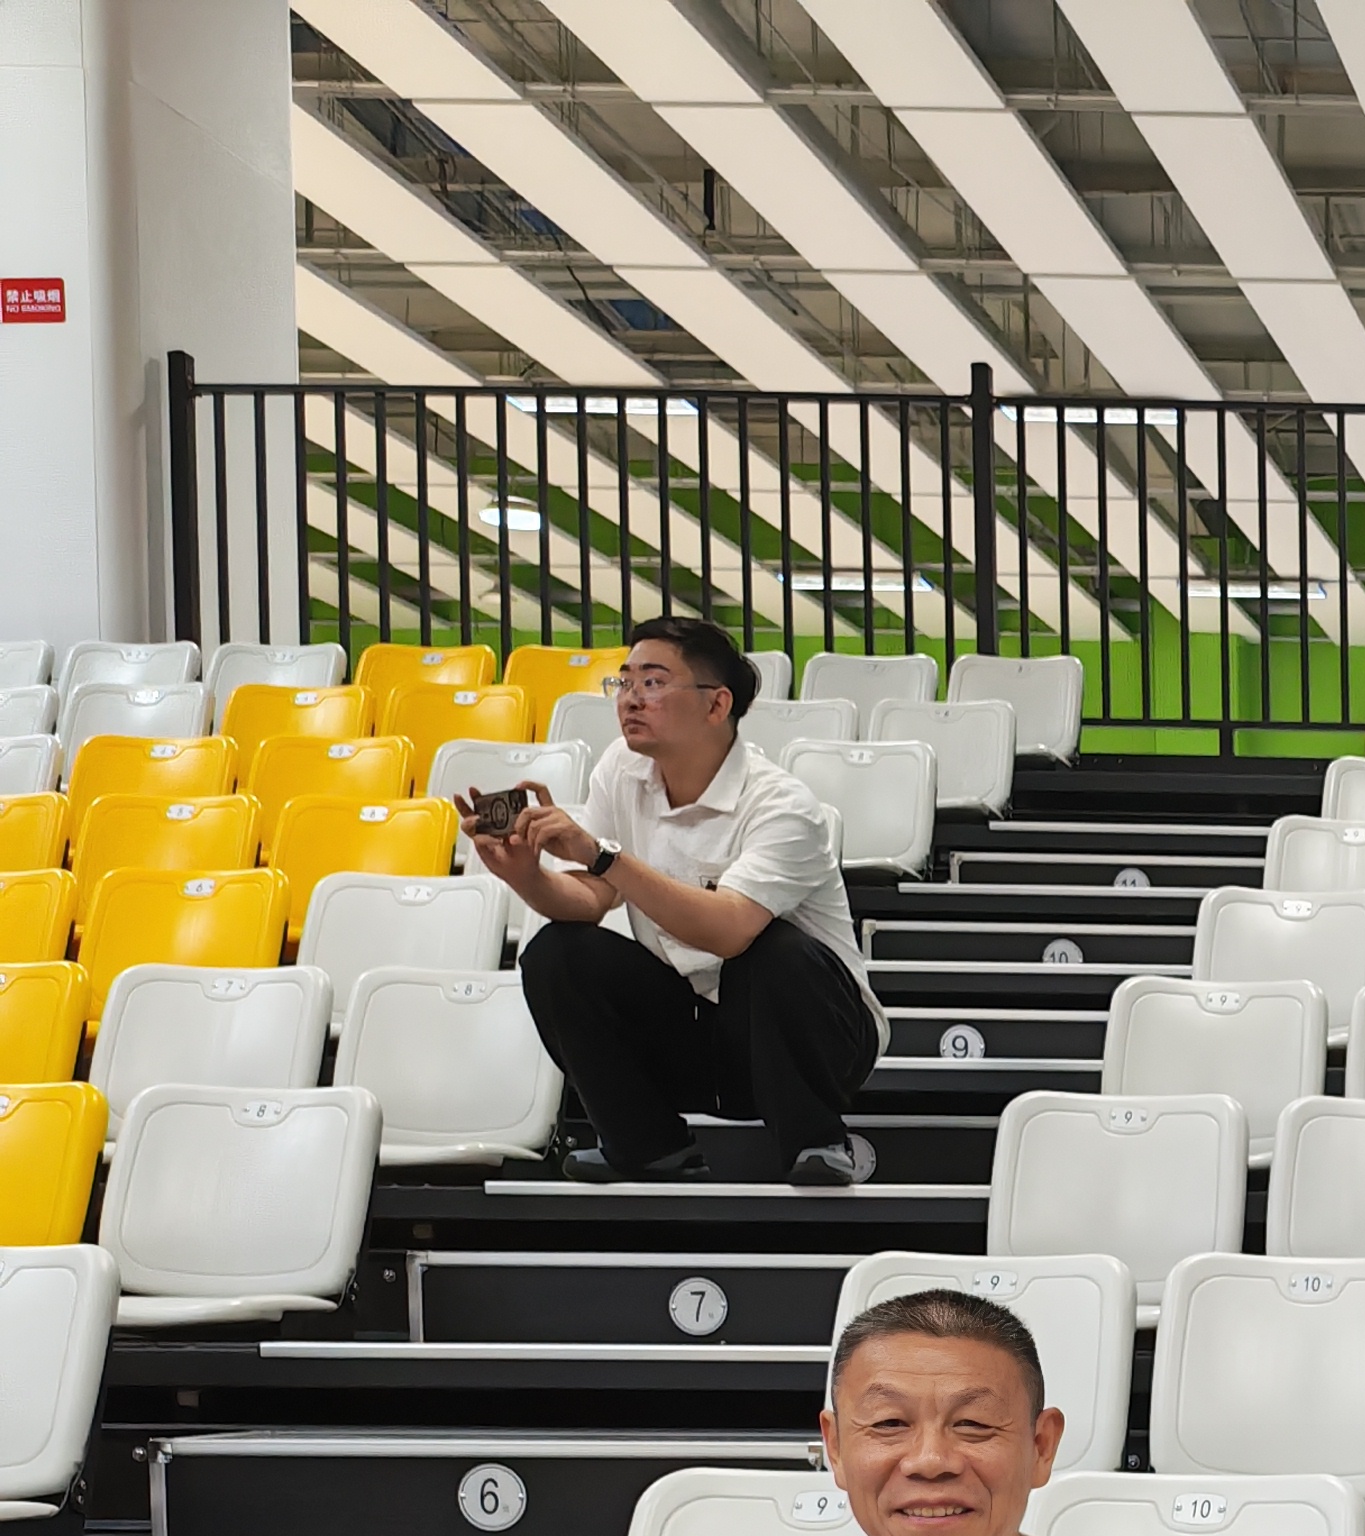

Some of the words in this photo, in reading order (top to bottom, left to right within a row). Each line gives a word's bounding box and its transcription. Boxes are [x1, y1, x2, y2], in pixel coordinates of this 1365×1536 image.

[6, 289, 61, 303] 禁止吸烟
[6, 305, 19, 313] NO
[225, 981, 234, 994] 7
[1220, 995, 1227, 1006] 9
[953, 1036, 968, 1058] 9
[1125, 1111, 1133, 1125] 9
[991, 1275, 1000, 1291] 9
[1304, 1276, 1321, 1292] 10
[691, 1291, 706, 1322] 7
[481, 1478, 499, 1514] 6
[817, 1497, 828, 1516] 9
[1191, 1499, 1212, 1519] 10
